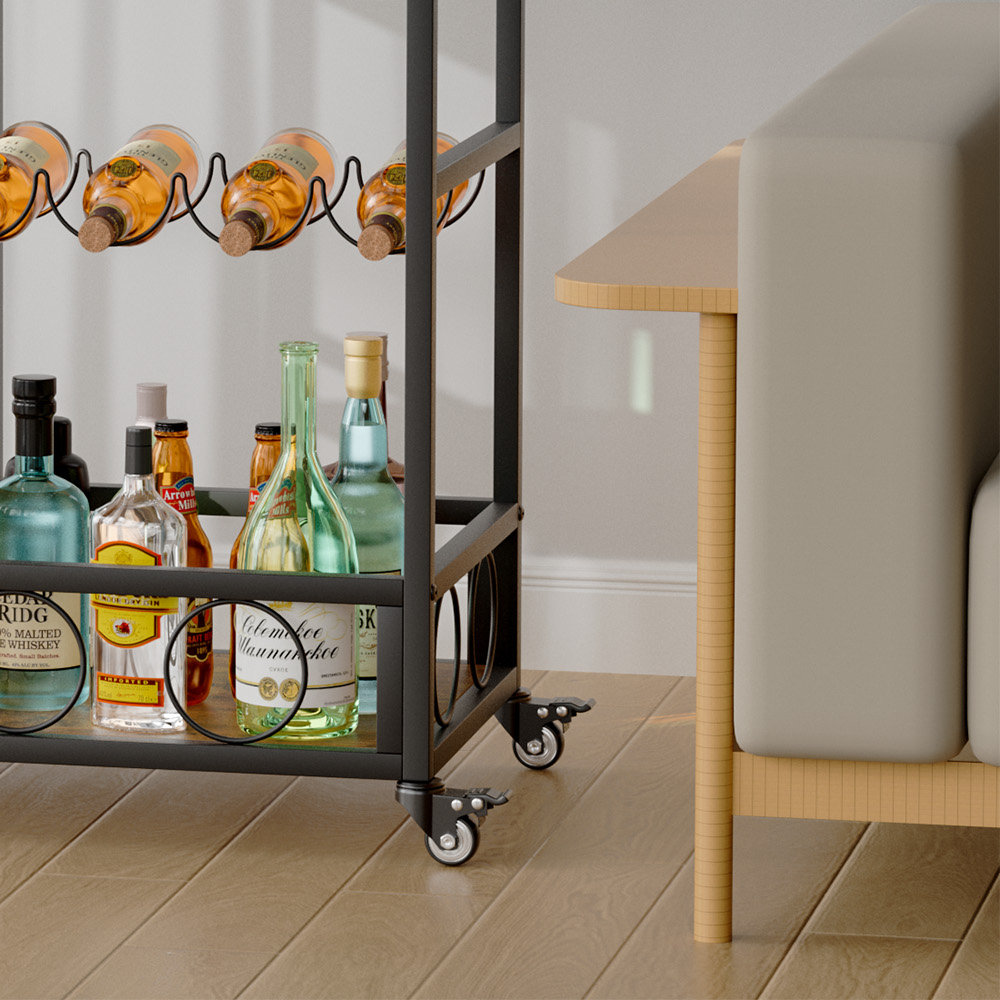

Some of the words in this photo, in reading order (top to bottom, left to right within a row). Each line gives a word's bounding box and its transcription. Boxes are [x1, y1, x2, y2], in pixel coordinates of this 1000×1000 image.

[14, 628, 62, 639] MALTED
[8, 639, 61, 650] WHISKEY
[103, 675, 149, 685] IMPORTED
